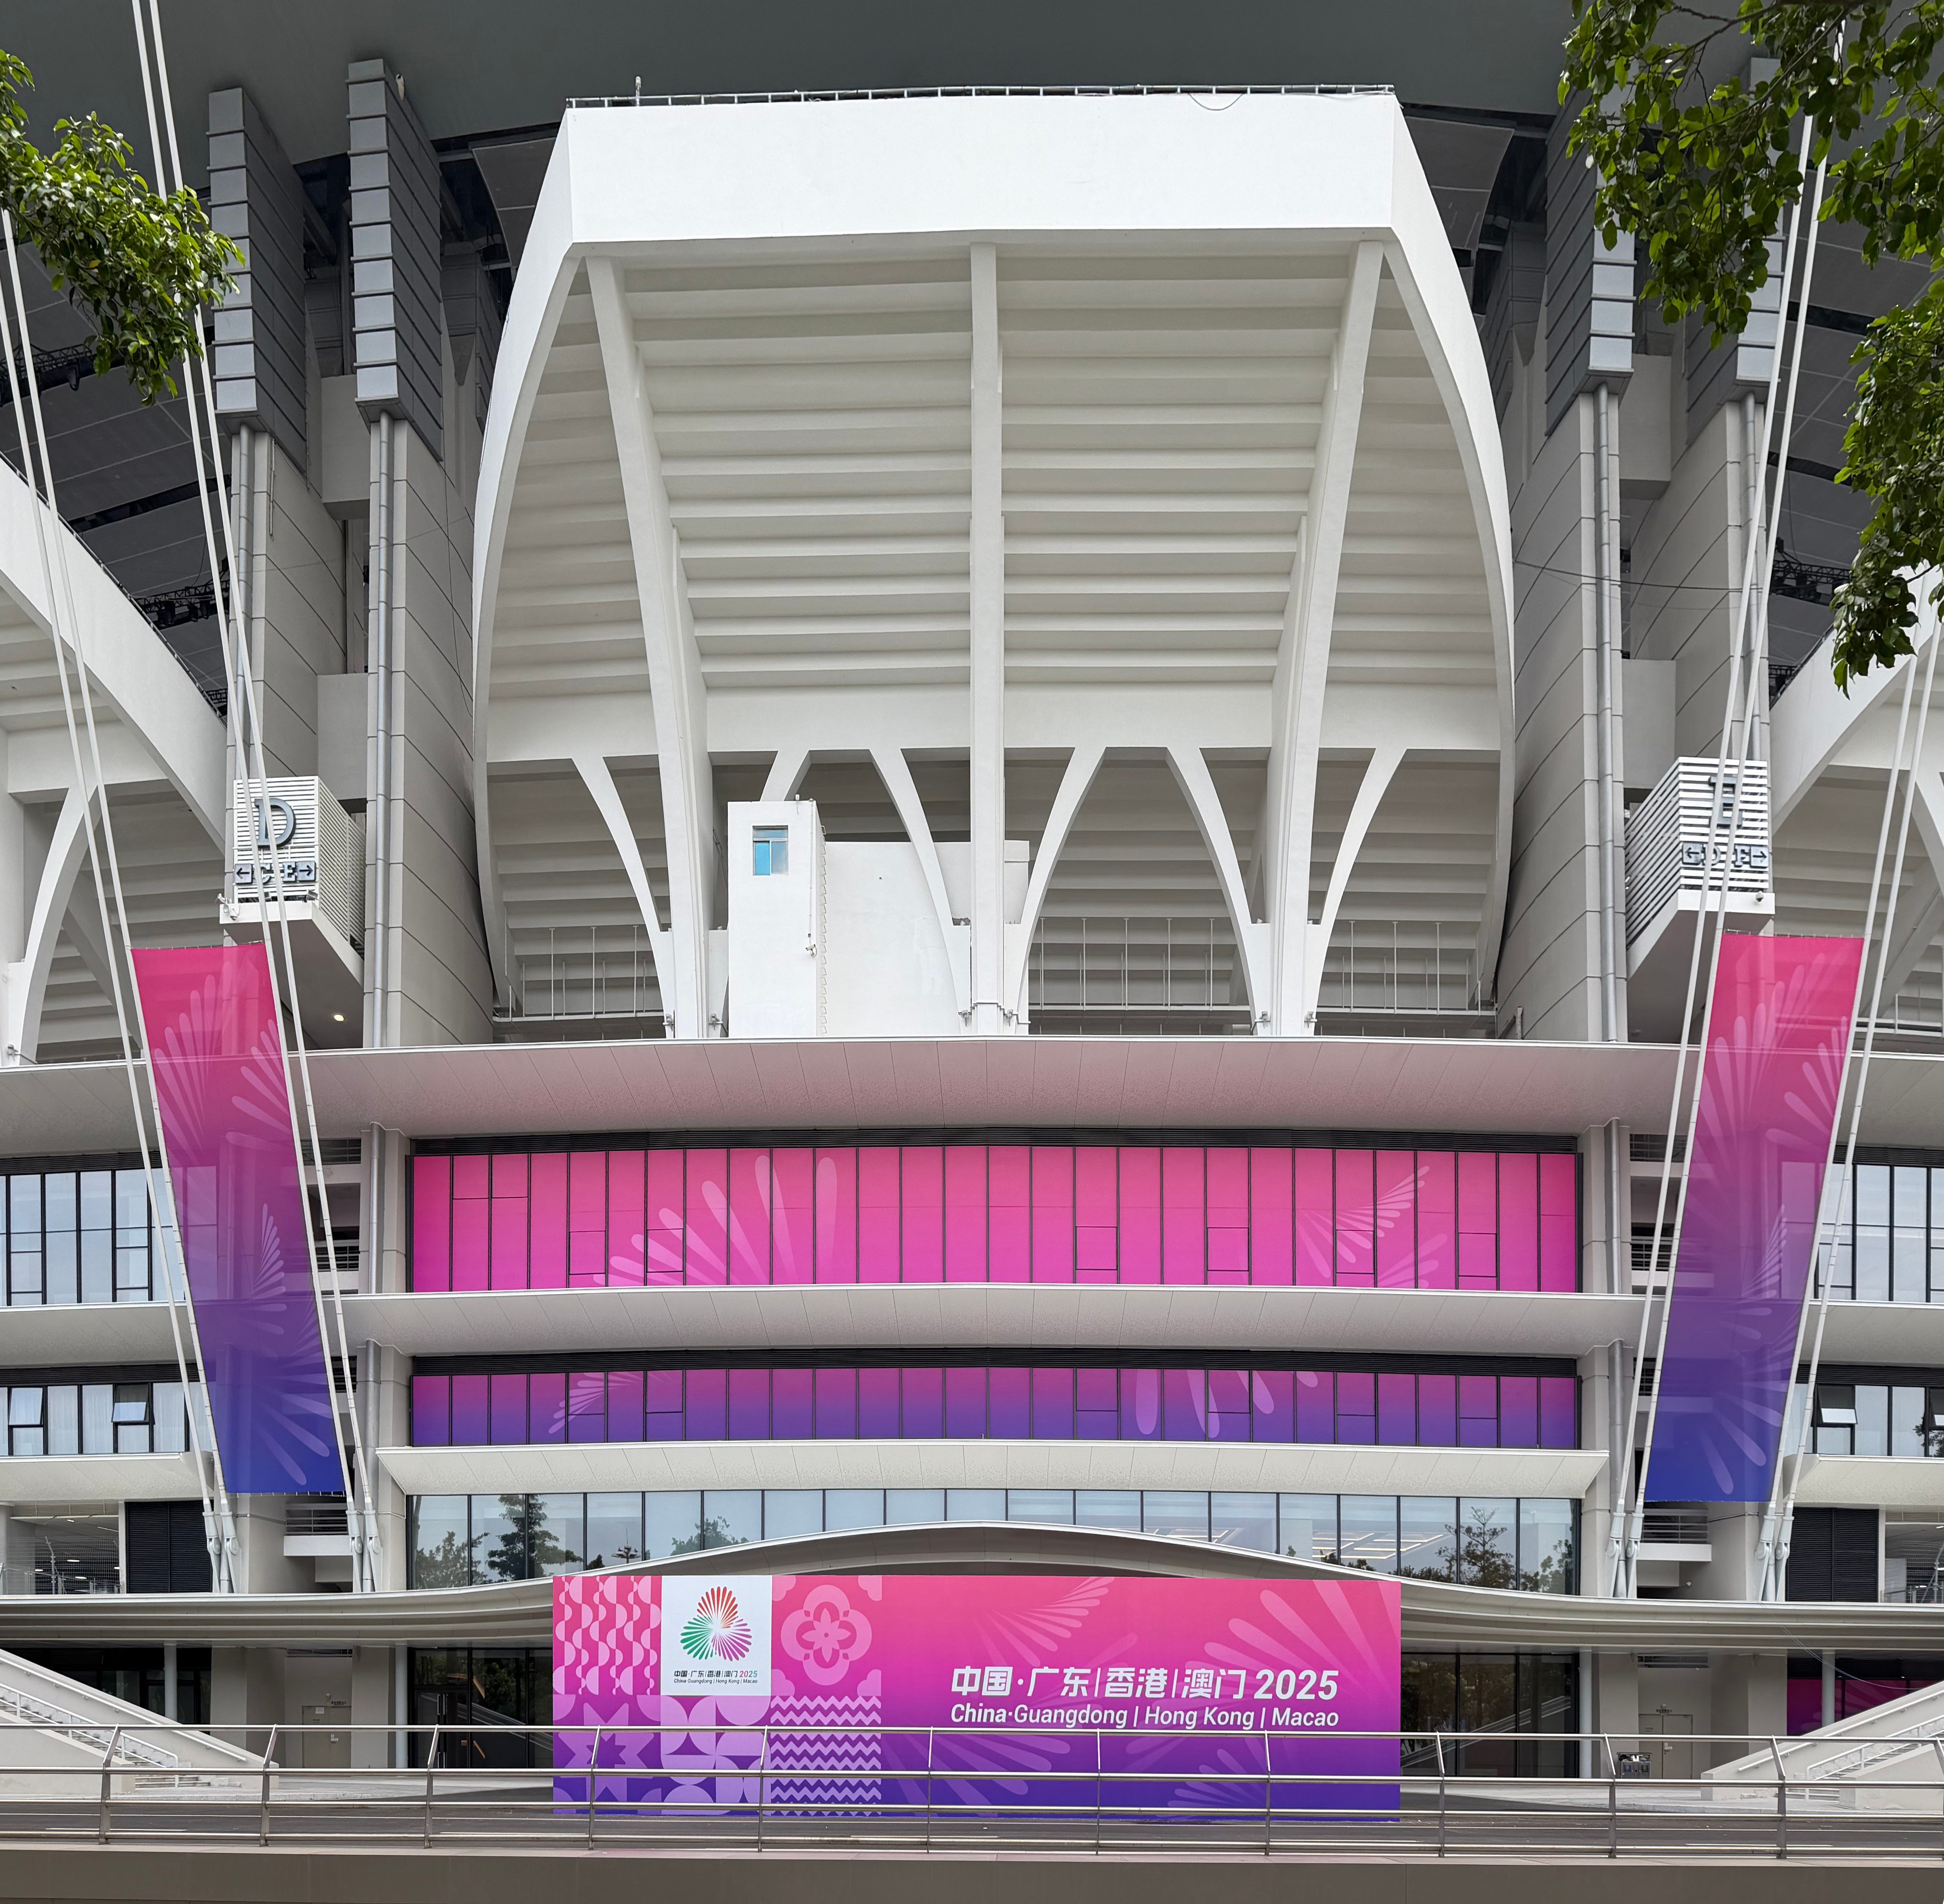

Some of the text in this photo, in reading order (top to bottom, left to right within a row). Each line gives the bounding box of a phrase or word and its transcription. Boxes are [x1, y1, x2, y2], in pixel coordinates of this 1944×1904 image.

[254, 797, 295, 847] D
[1703, 844, 1750, 867] D F
[283, 861, 297, 882] E
[1254, 1669, 1339, 1700] 2025
[1145, 1706, 1197, 1729] Hong
[1203, 1707, 1255, 1730] Kong
[1272, 1707, 1339, 1726] Macao
